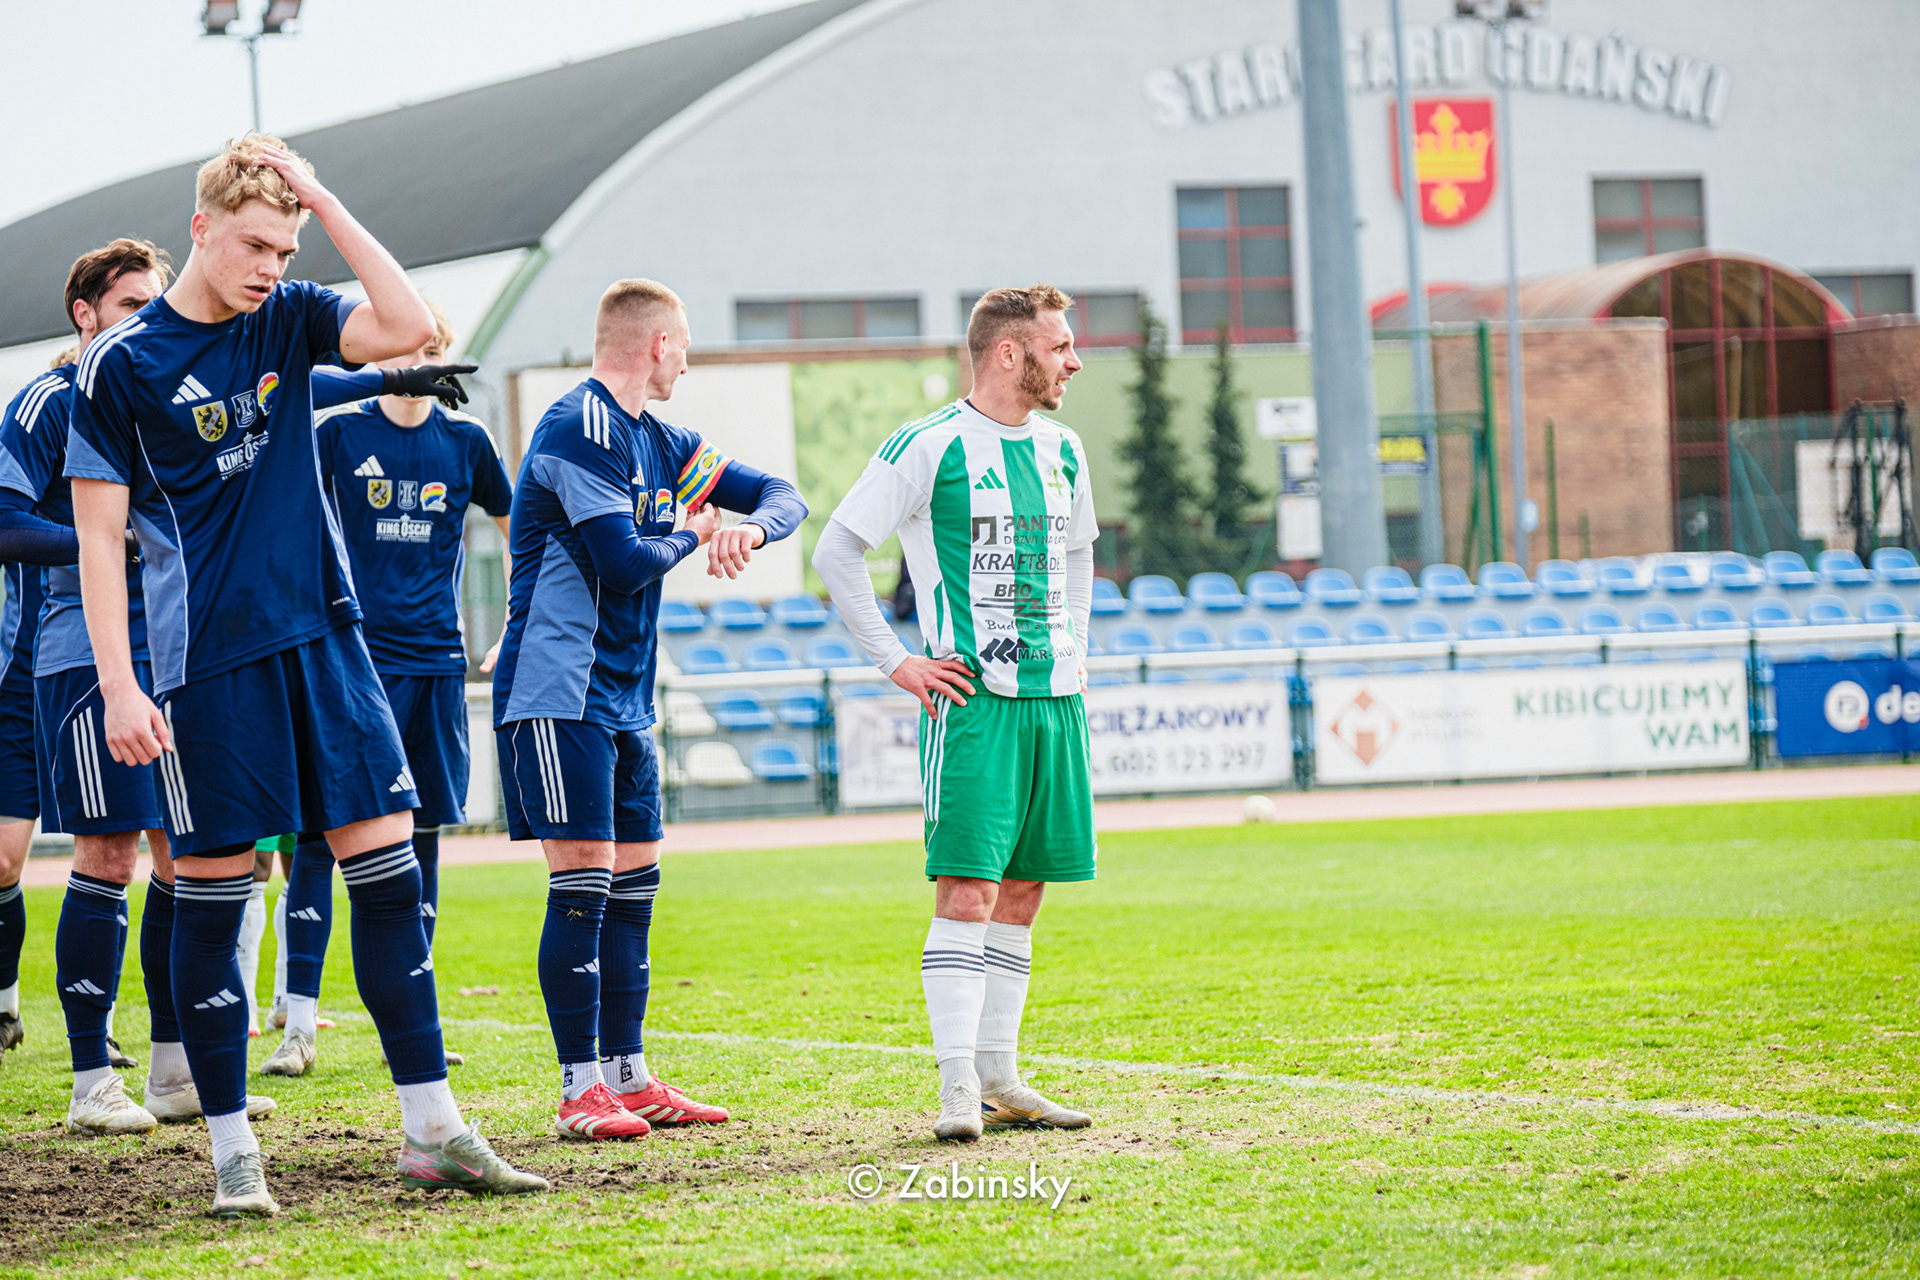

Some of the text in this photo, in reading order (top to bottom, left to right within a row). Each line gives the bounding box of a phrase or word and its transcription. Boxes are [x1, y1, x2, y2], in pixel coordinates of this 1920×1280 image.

[1487, 19, 1731, 128] GDAŃSKI
[216, 448, 244, 472] KING
[697, 452, 718, 476] C
[376, 521, 432, 537] KING OSCAR
[1004, 535, 1038, 545] DRZWI
[1041, 535, 1053, 545] NA
[985, 619, 1030, 632] Buduj
[1514, 678, 1735, 717] KIBICUJEMY
[1645, 718, 1740, 748] WAM
